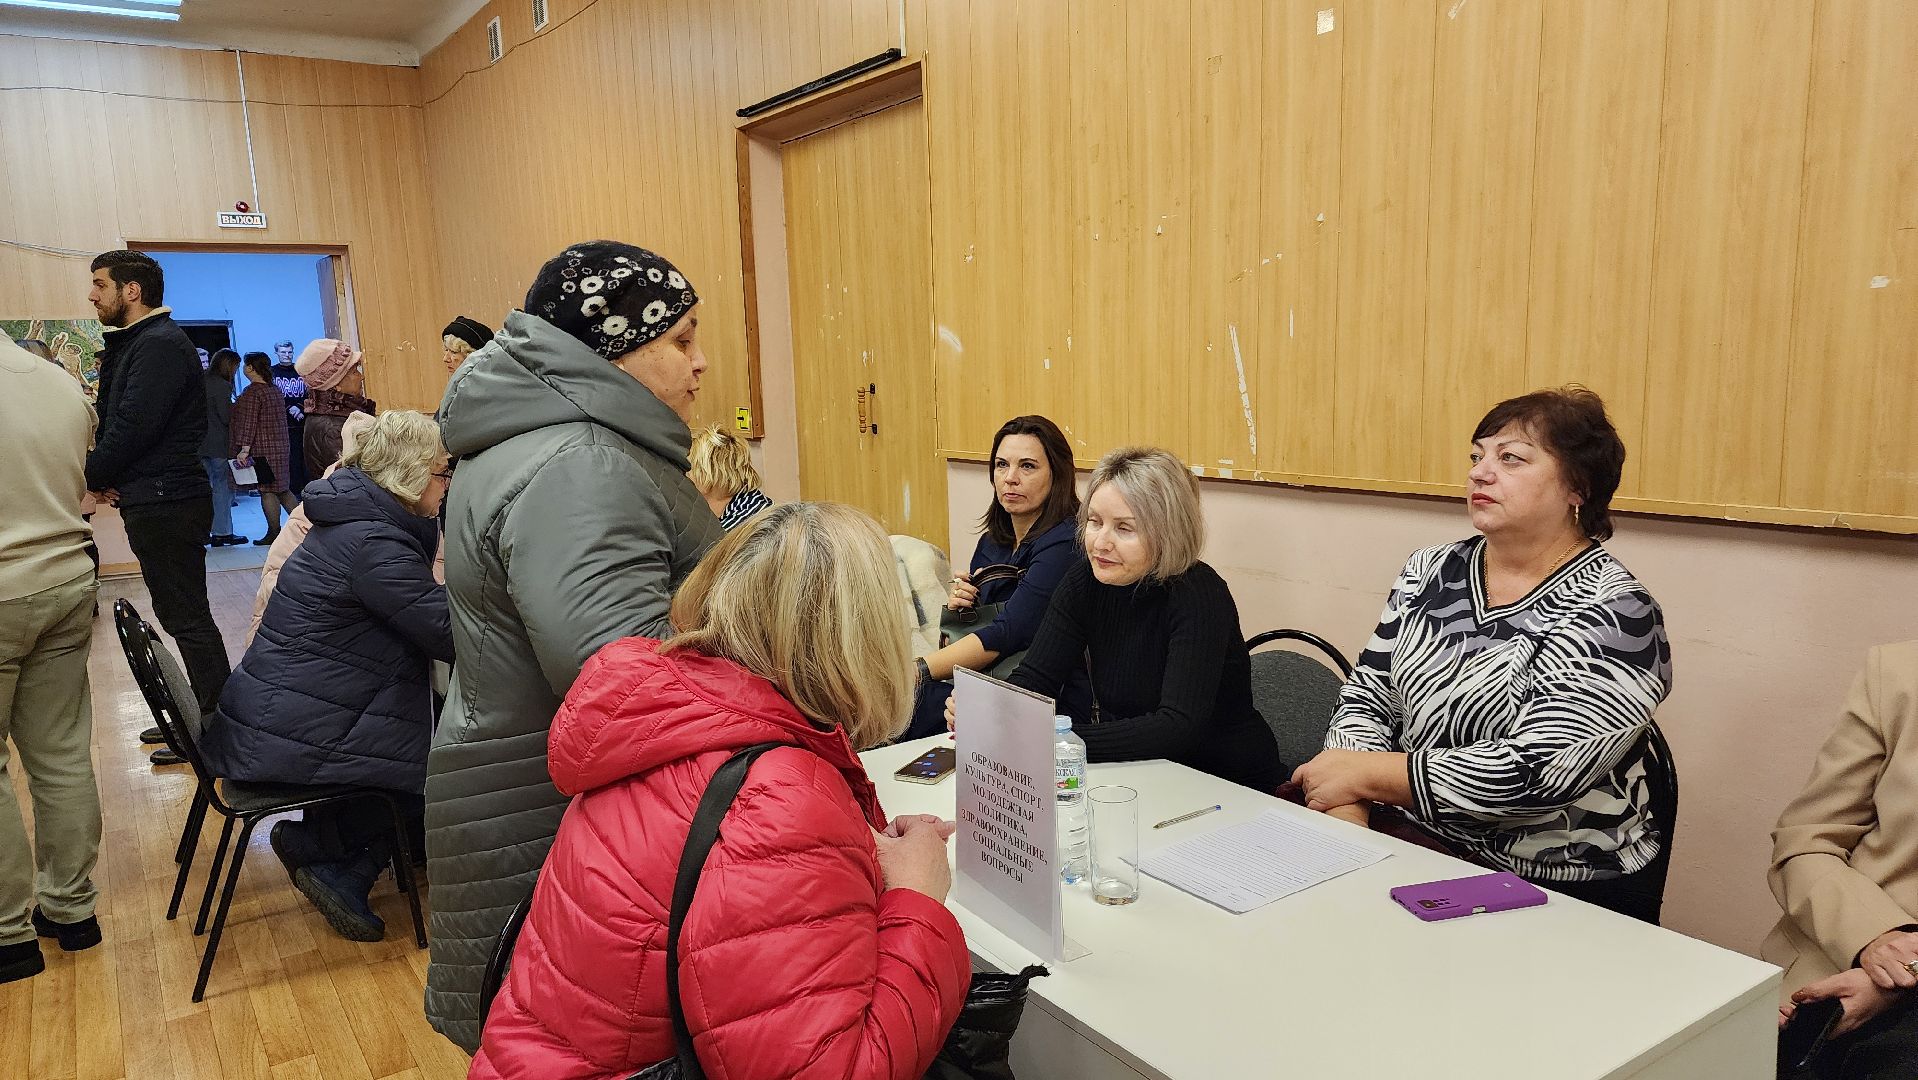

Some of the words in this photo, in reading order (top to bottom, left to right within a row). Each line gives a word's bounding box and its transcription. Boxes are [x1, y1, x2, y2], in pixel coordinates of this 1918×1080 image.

[221, 215, 262, 225] ВЫХОД
[965, 763, 1010, 796] КУЛЬТУРА,
[971, 751, 1036, 791] ОБРАЗОВАНИЕ,
[972, 783, 1034, 822] МОЛОДЕЖНАЯ
[977, 801, 1028, 838] ПОЛИТИКА,
[961, 808, 1048, 866] ЗДРАВООХРАНЕНИЕ,
[972, 830, 1034, 873] СОЦИАЛЬНЫЕ
[981, 850, 1024, 884] ВОПРОСЫ
